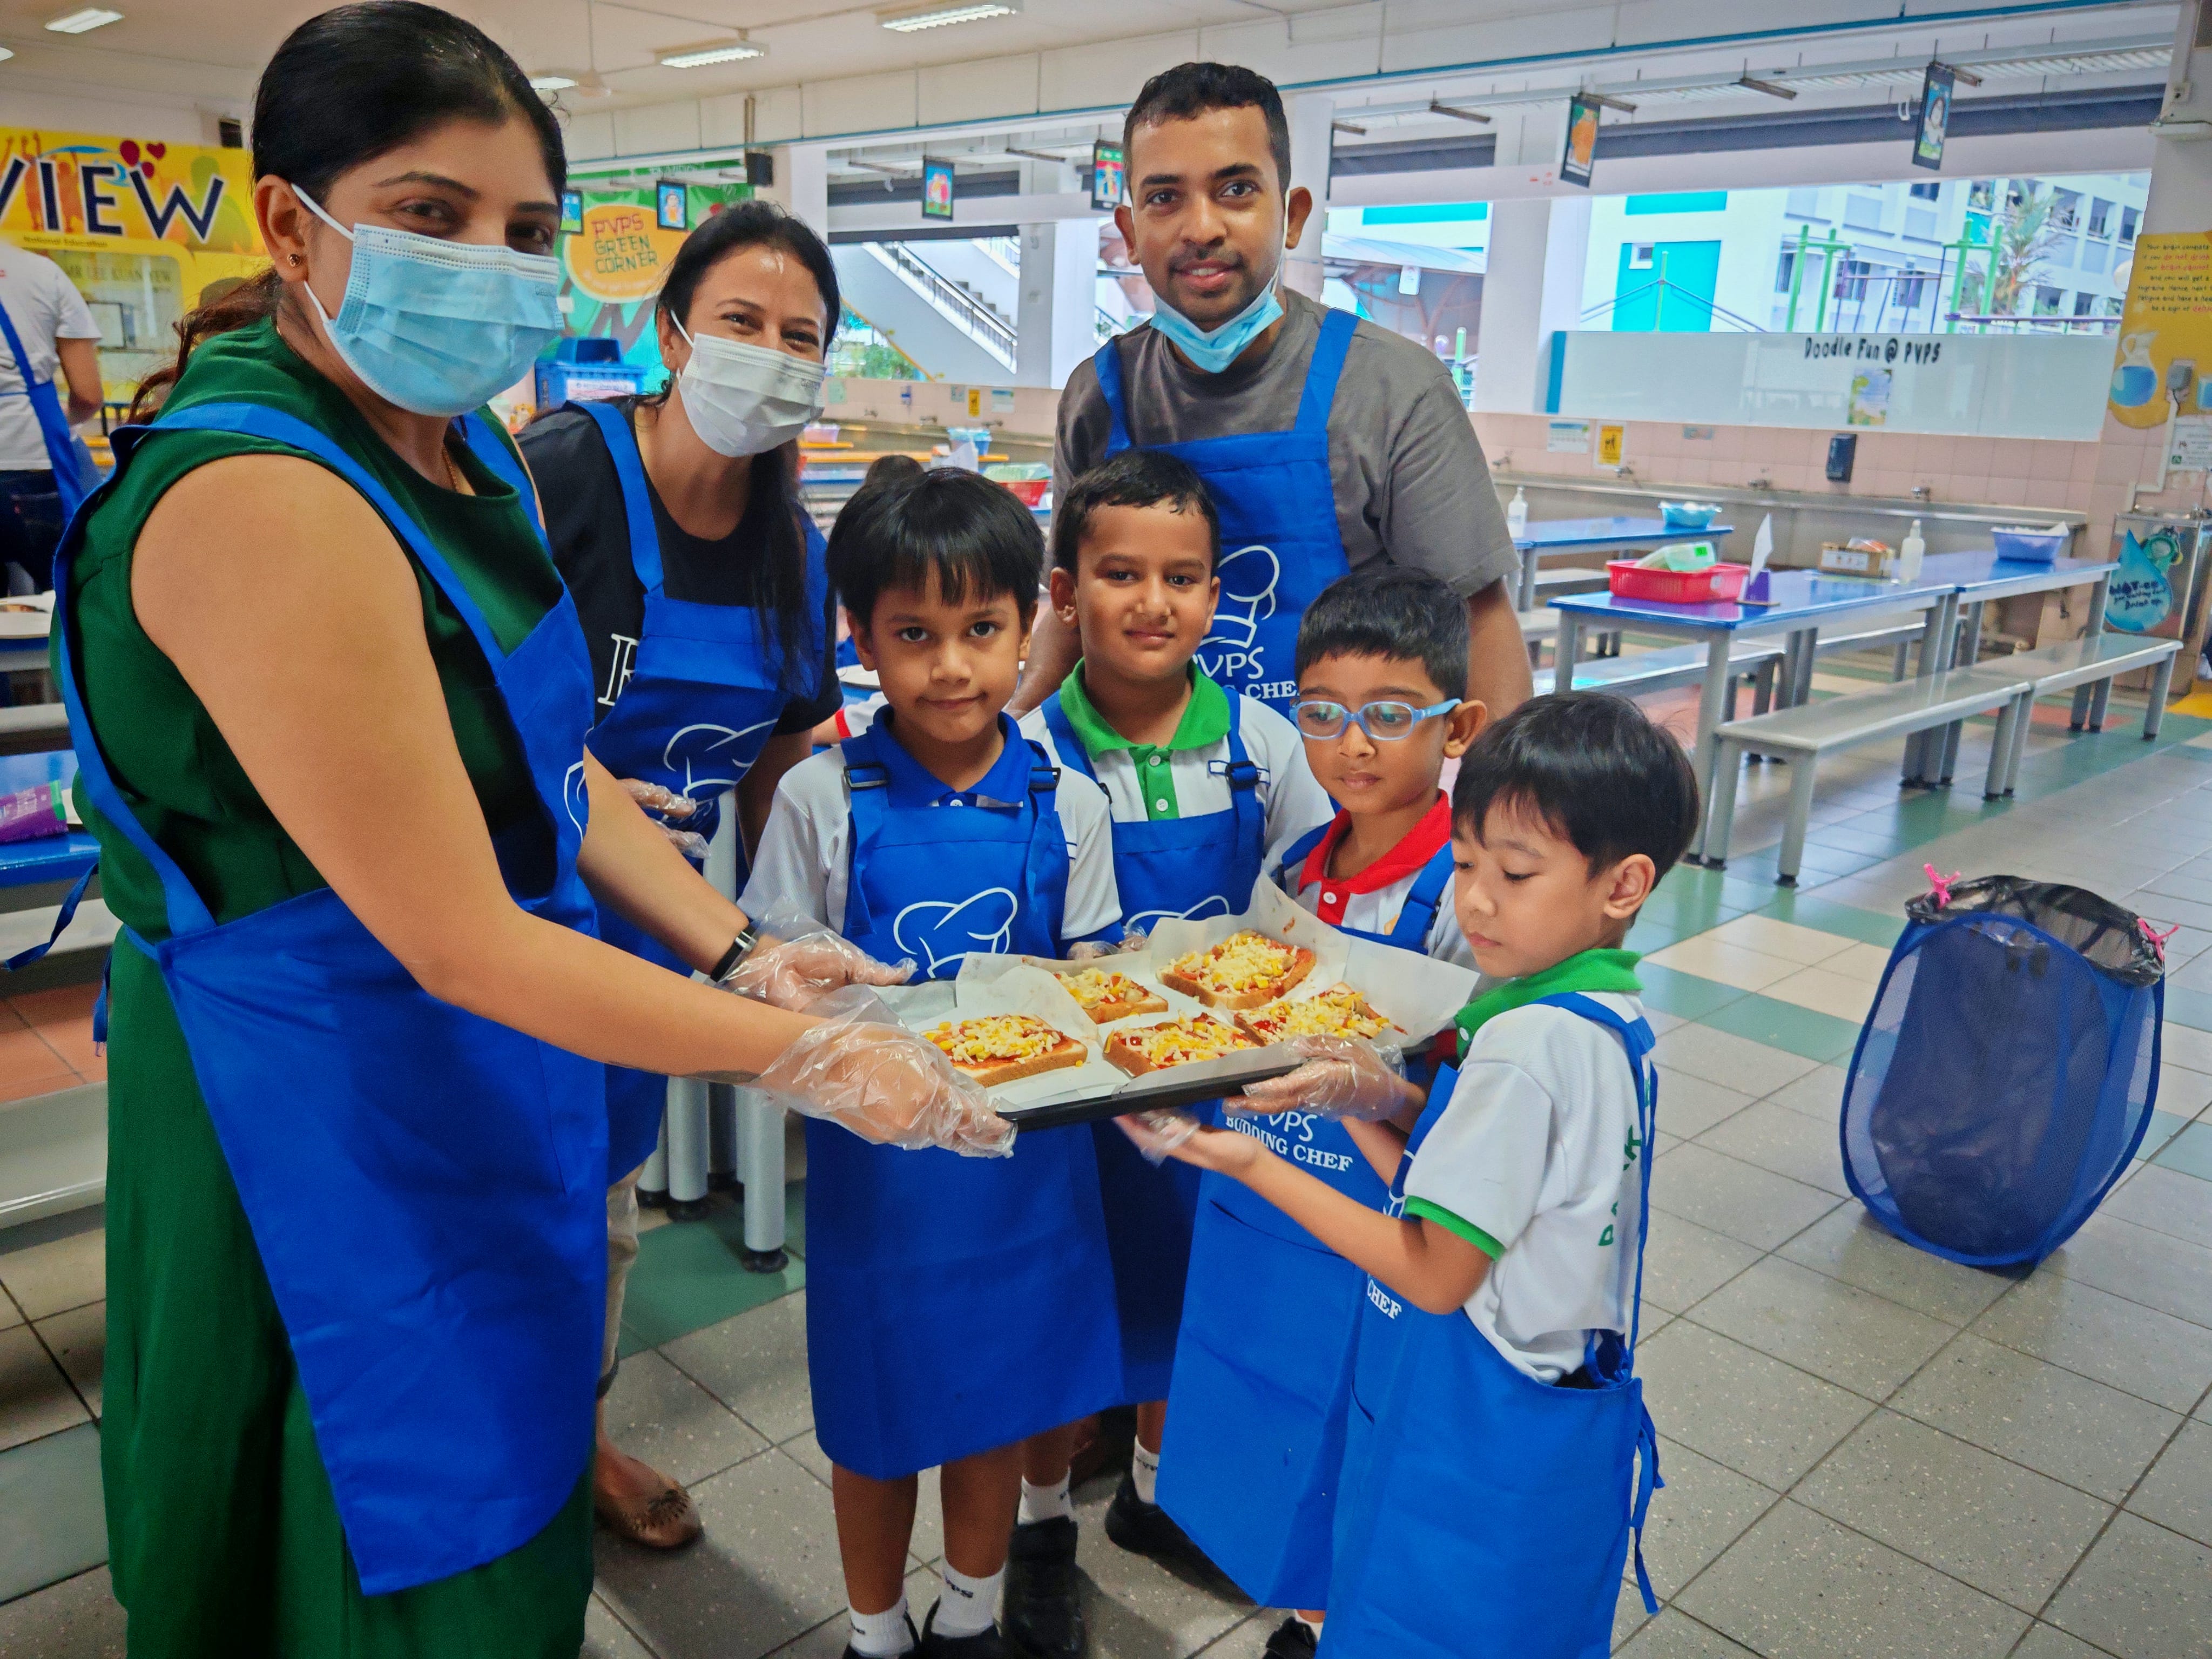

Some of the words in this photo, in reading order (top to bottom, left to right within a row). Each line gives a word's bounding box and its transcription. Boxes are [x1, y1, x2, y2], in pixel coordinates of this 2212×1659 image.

[591, 213, 644, 238] PVPS
[594, 234, 651, 255] GREEN
[595, 251, 659, 274] CORNER
[1804, 336, 1852, 359] Doodle
[1857, 338, 1880, 360] Fun
[1884, 338, 1899, 364] @
[1904, 341, 1941, 365] PVPS
[1244, 680, 1300, 700] CHE
[1253, 1110, 1318, 1142] VPS
[1225, 1116, 1289, 1156] BUDDING
[1292, 1144, 1353, 1172] CHEF
